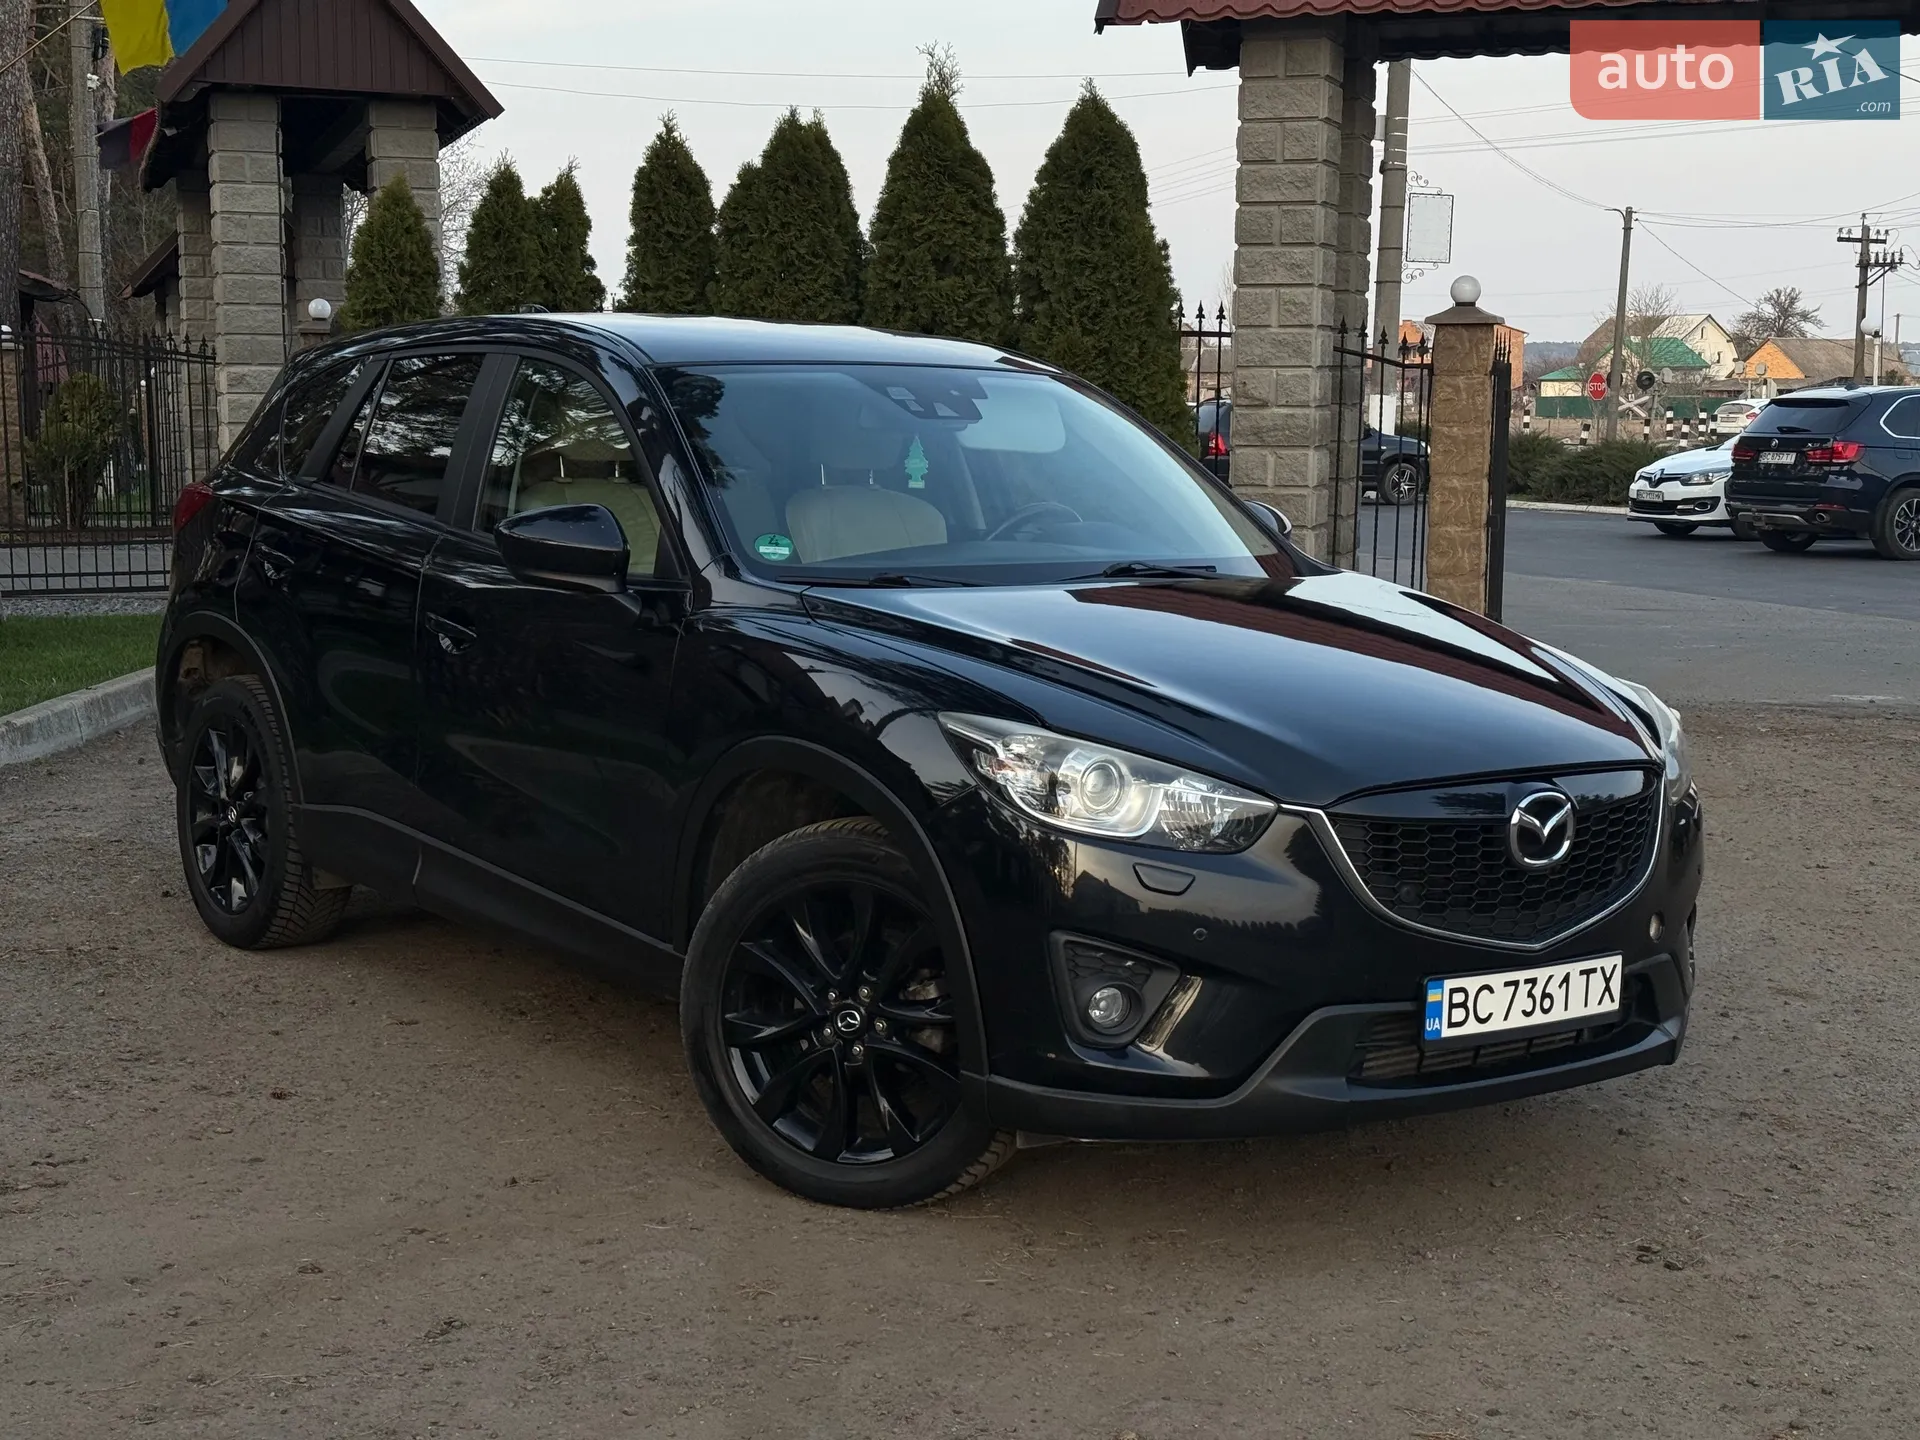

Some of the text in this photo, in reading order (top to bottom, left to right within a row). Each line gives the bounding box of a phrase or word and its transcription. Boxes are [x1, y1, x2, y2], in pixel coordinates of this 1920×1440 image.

[1589, 382, 1606, 391] STOP
[1447, 963, 1618, 1029] BC 7361 TX
[1426, 1018, 1440, 1031] UA
